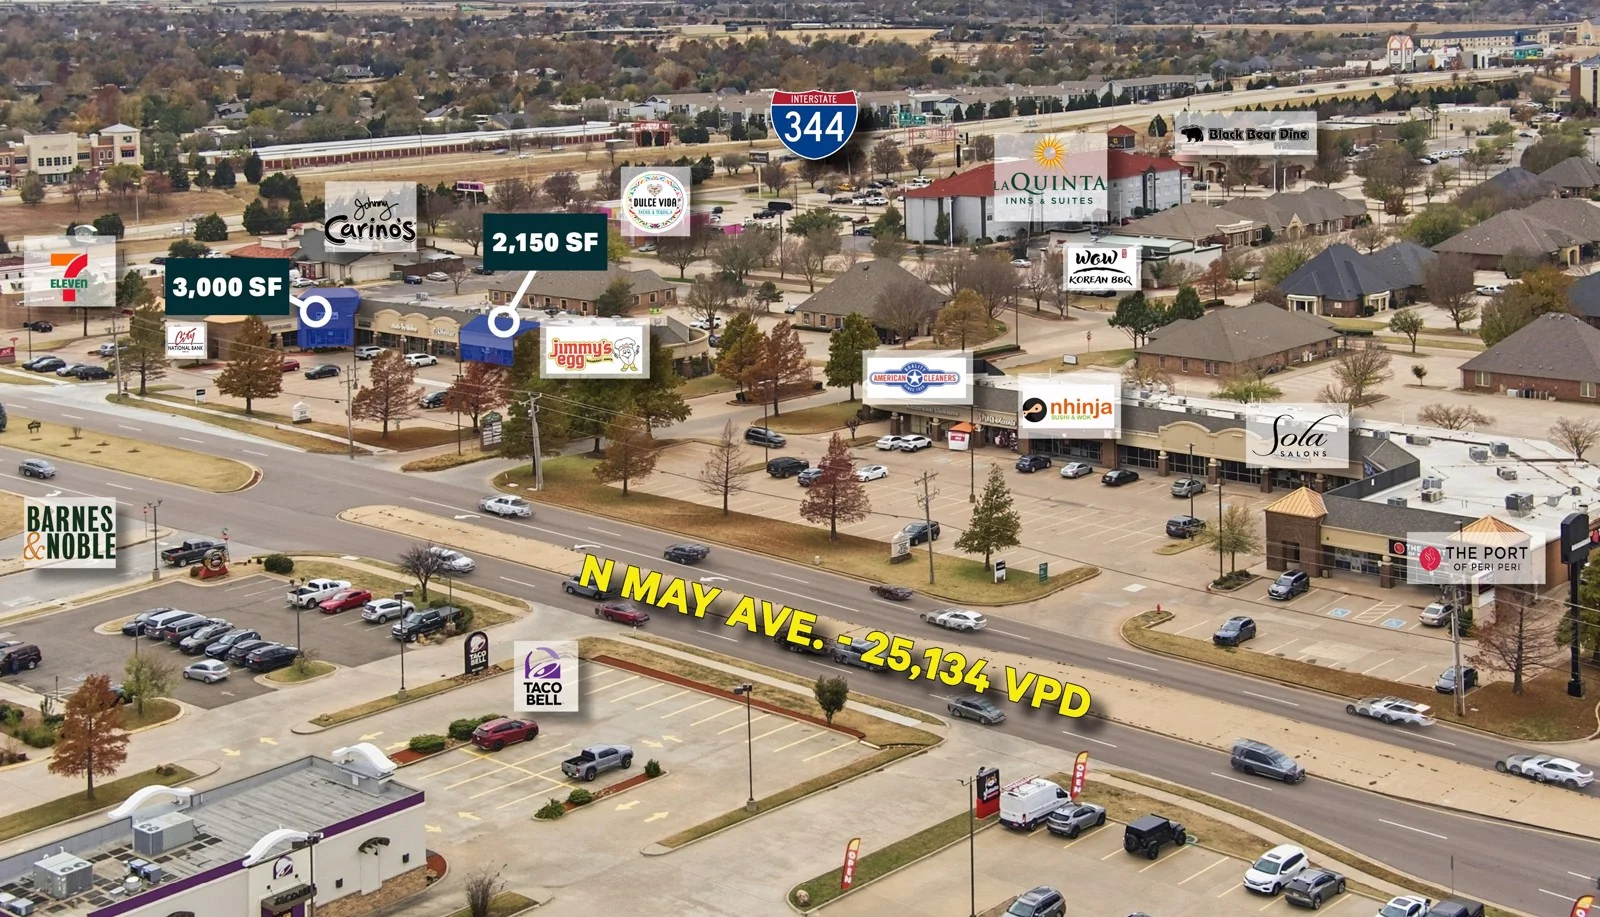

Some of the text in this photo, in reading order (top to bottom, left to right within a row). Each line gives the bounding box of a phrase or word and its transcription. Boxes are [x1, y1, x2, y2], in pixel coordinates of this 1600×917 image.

[469, 650, 487, 660] TACO
[470, 657, 487, 666] BELL
[1073, 763, 1085, 794] OPEN
[843, 851, 856, 884] OPEN
